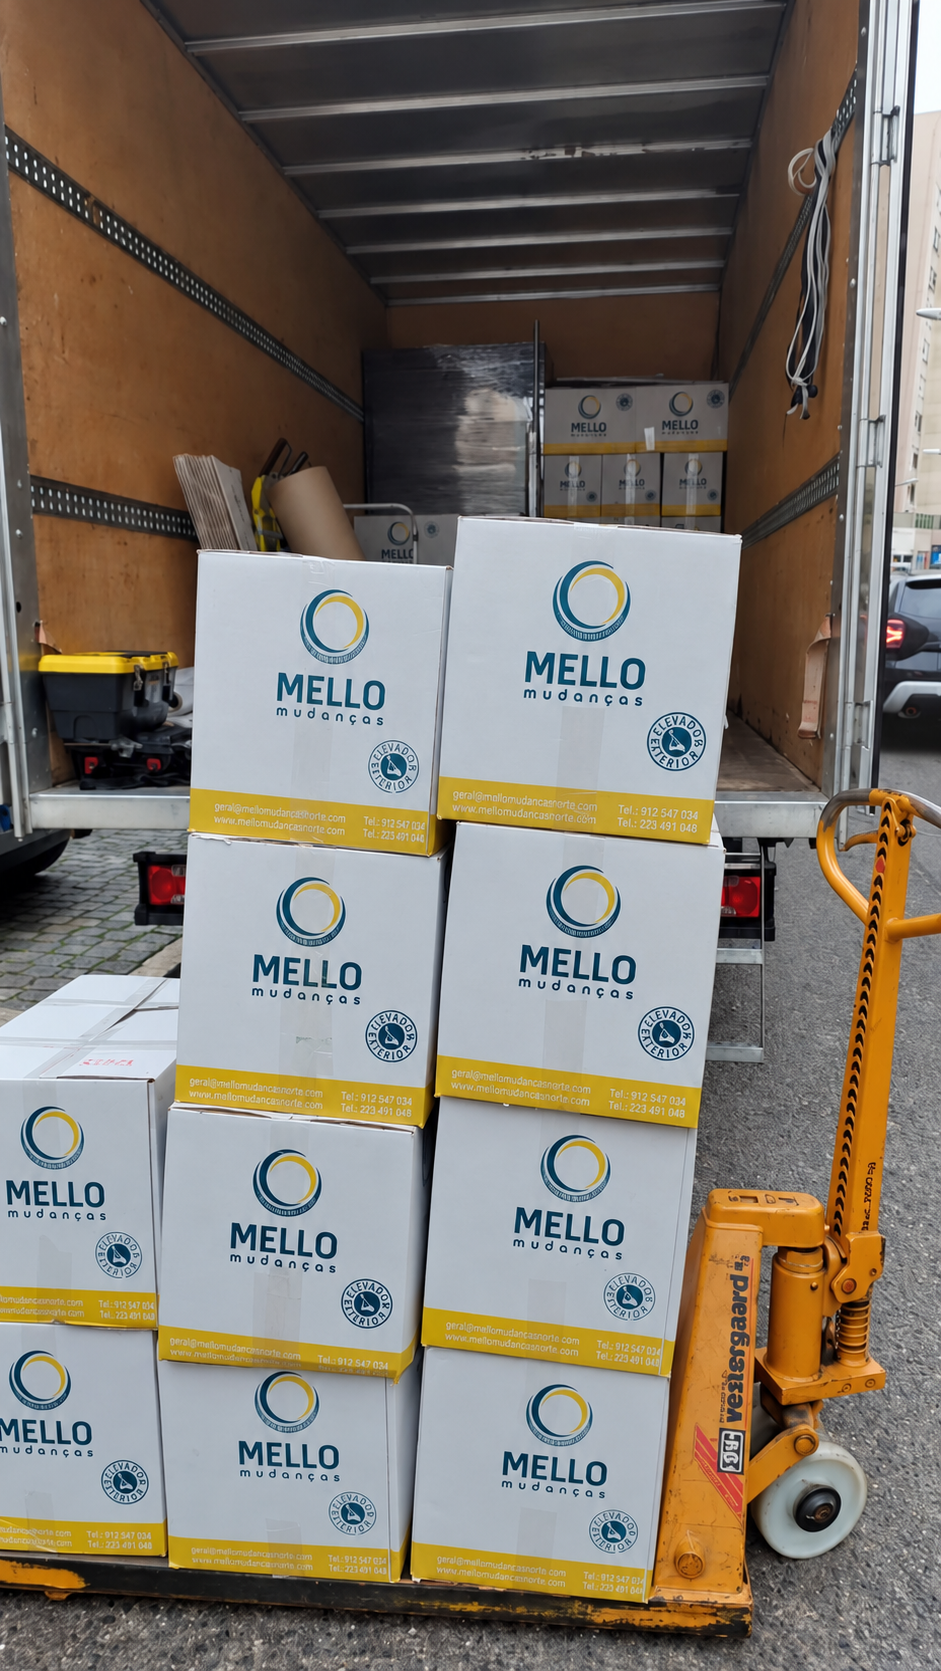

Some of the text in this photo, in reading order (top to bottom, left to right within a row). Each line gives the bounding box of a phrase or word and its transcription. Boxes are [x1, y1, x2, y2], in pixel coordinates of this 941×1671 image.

[571, 422, 607, 432] MELLO
[662, 419, 698, 430] MELLO
[524, 651, 646, 690] MELLO
[277, 672, 386, 710] MELLO
[524, 689, 642, 706] mudanças
[276, 706, 384, 725] mudanças
[653, 715, 703, 747] ELEVADOR
[373, 743, 417, 771] ELEVADOR
[651, 738, 698, 768] EXTERIOR
[618, 805, 698, 820] Tel.: 912 547 034
[382, 818, 395, 828] 912
[396, 820, 410, 829] 547
[412, 821, 425, 830] 034
[618, 818, 697, 833] Tel.: 223 491 048
[396, 832, 409, 841] 491
[253, 954, 362, 990] MELLO
[520, 944, 636, 984] MELLO
[252, 987, 360, 1005] mudanças
[519, 978, 633, 1000] mudanças
[645, 1010, 692, 1039] ELEVADOR
[368, 1032, 411, 1060] EXTERIOR
[641, 1029, 687, 1058] EXTERIOR
[361, 1094, 375, 1102] 912
[378, 1095, 394, 1104] 547
[396, 1097, 412, 1106] 034
[610, 1089, 686, 1106] Tel.: 912 547 034
[341, 1104, 412, 1117] Tel.: 223 491 048
[609, 1101, 685, 1119] Tel.: 223 491 048
[6, 1180, 104, 1208] MELLO
[8, 1209, 106, 1221] mudanças
[514, 1207, 625, 1246] MELLO
[230, 1222, 337, 1259] MELLO
[513, 1238, 622, 1260] mudanças
[230, 1253, 336, 1273] mudanças
[347, 1282, 390, 1310] ELEVADOR
[616, 1342, 629, 1352] 912
[338, 1358, 353, 1366] 912
[356, 1359, 371, 1368] 547
[373, 1361, 388, 1370] 034
[614, 1353, 628, 1363] 223
[630, 1355, 643, 1365] 491
[0, 1418, 92, 1445] MELLO
[0, 1446, 93, 1458] mudanças
[239, 1440, 339, 1469] MELLO
[105, 1462, 146, 1485] ELEVADOR
[240, 1469, 340, 1482] mudanças
[502, 1451, 607, 1486] MELLO
[502, 1480, 605, 1499] mudanças
[334, 1494, 374, 1518] ELEVADOR
[344, 1555, 357, 1564] 912
[359, 1556, 372, 1564] 547
[601, 1573, 614, 1582] 912
[616, 1575, 630, 1583] 547
[616, 1585, 628, 1593] 491
